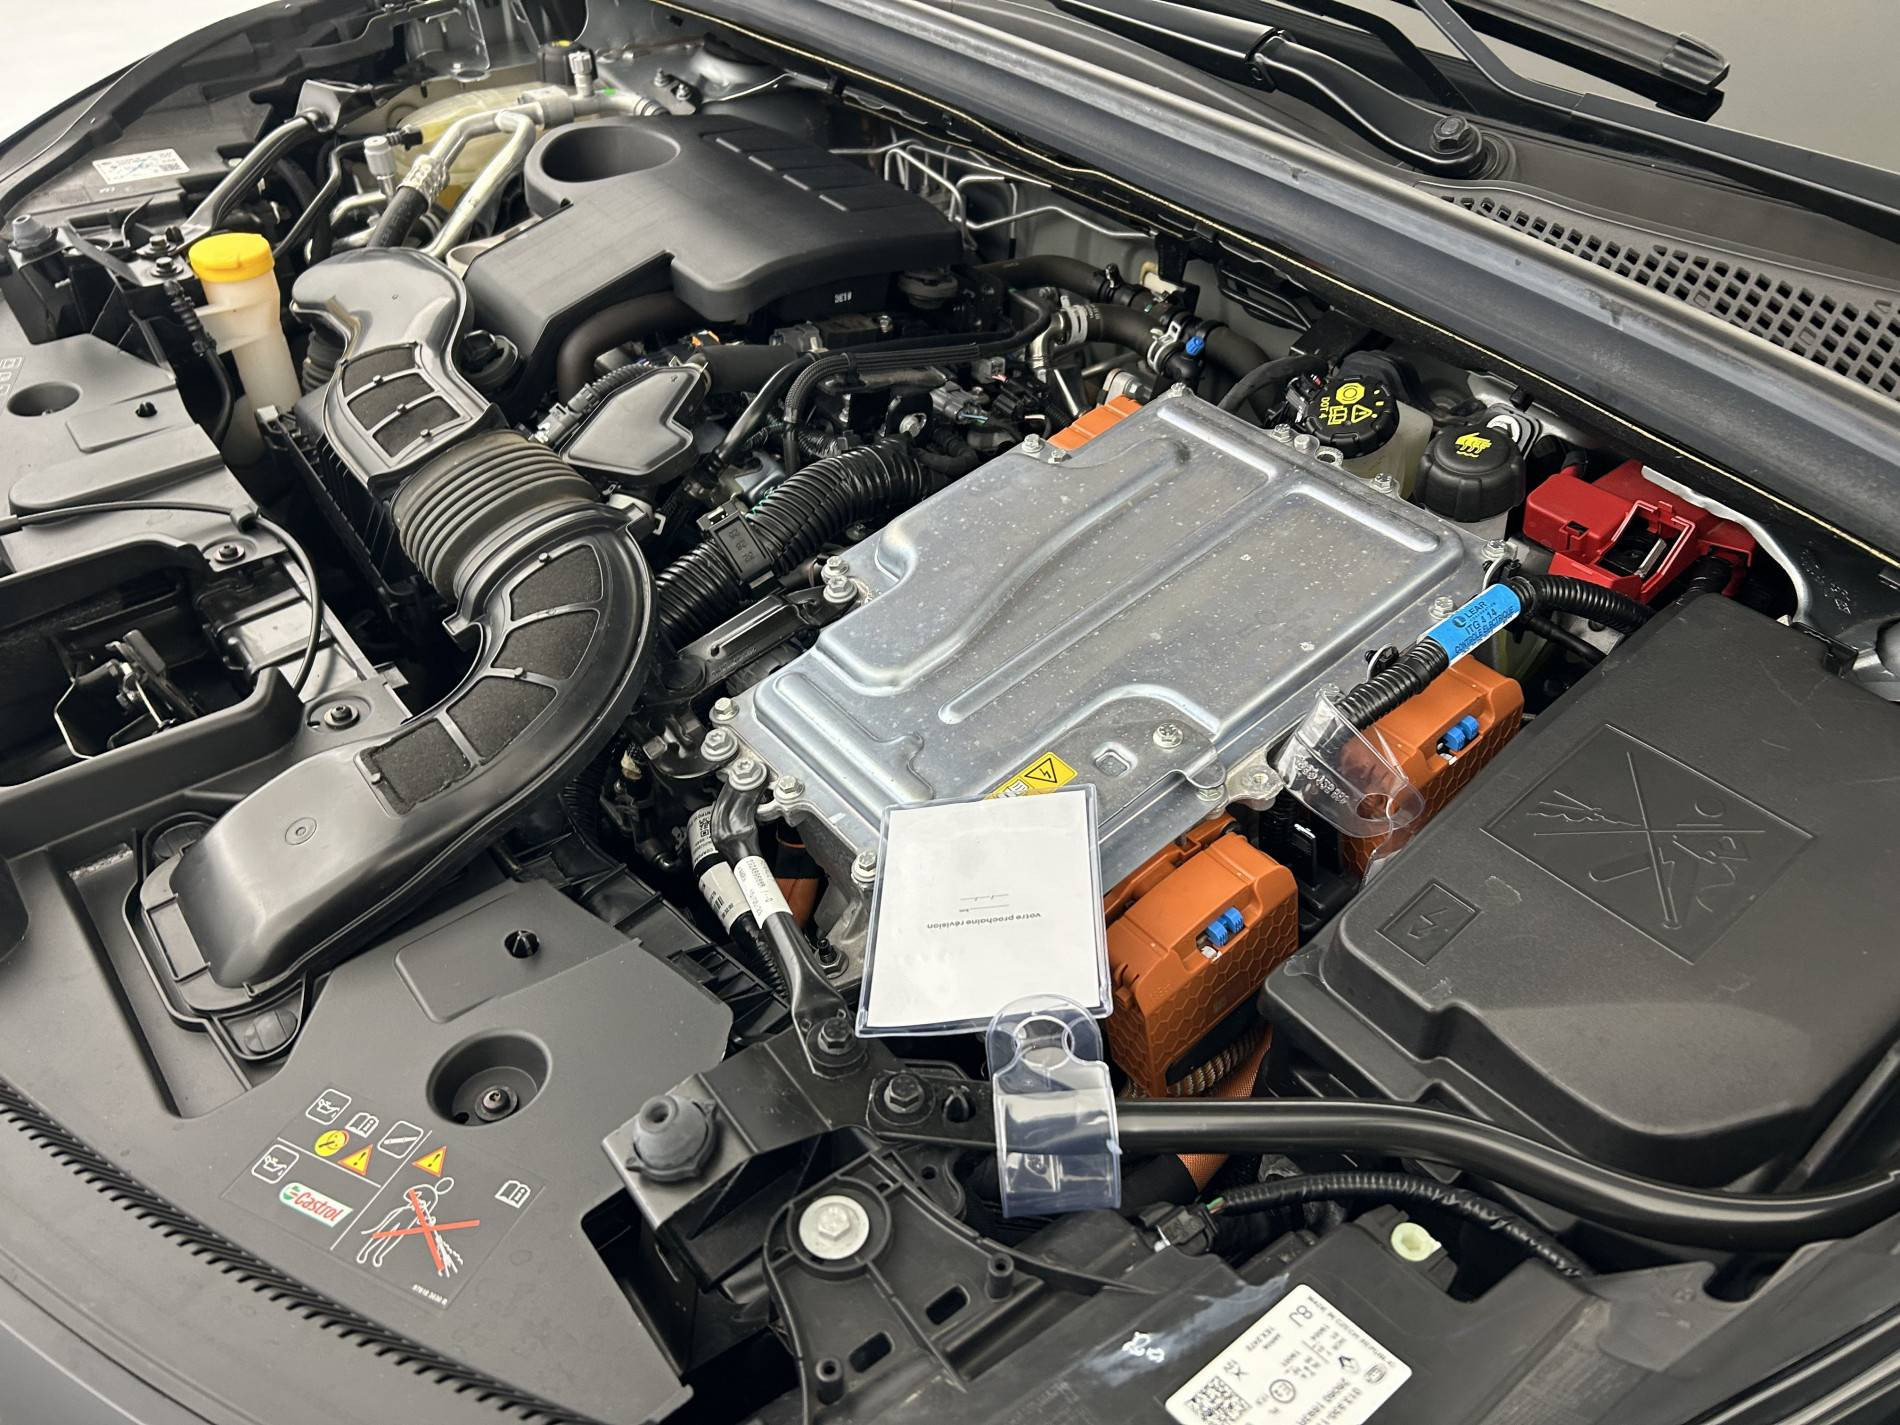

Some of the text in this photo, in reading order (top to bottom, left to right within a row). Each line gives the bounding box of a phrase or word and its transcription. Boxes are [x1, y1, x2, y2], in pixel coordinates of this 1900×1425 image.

[1320, 396, 1330, 412] DOT
[1464, 601, 1487, 618] LEAR
[1465, 620, 1481, 636] ITG
[1486, 608, 1497, 620] 14
[927, 912, 1042, 929] votre prochaine révision
[294, 1192, 344, 1221] Castrol
